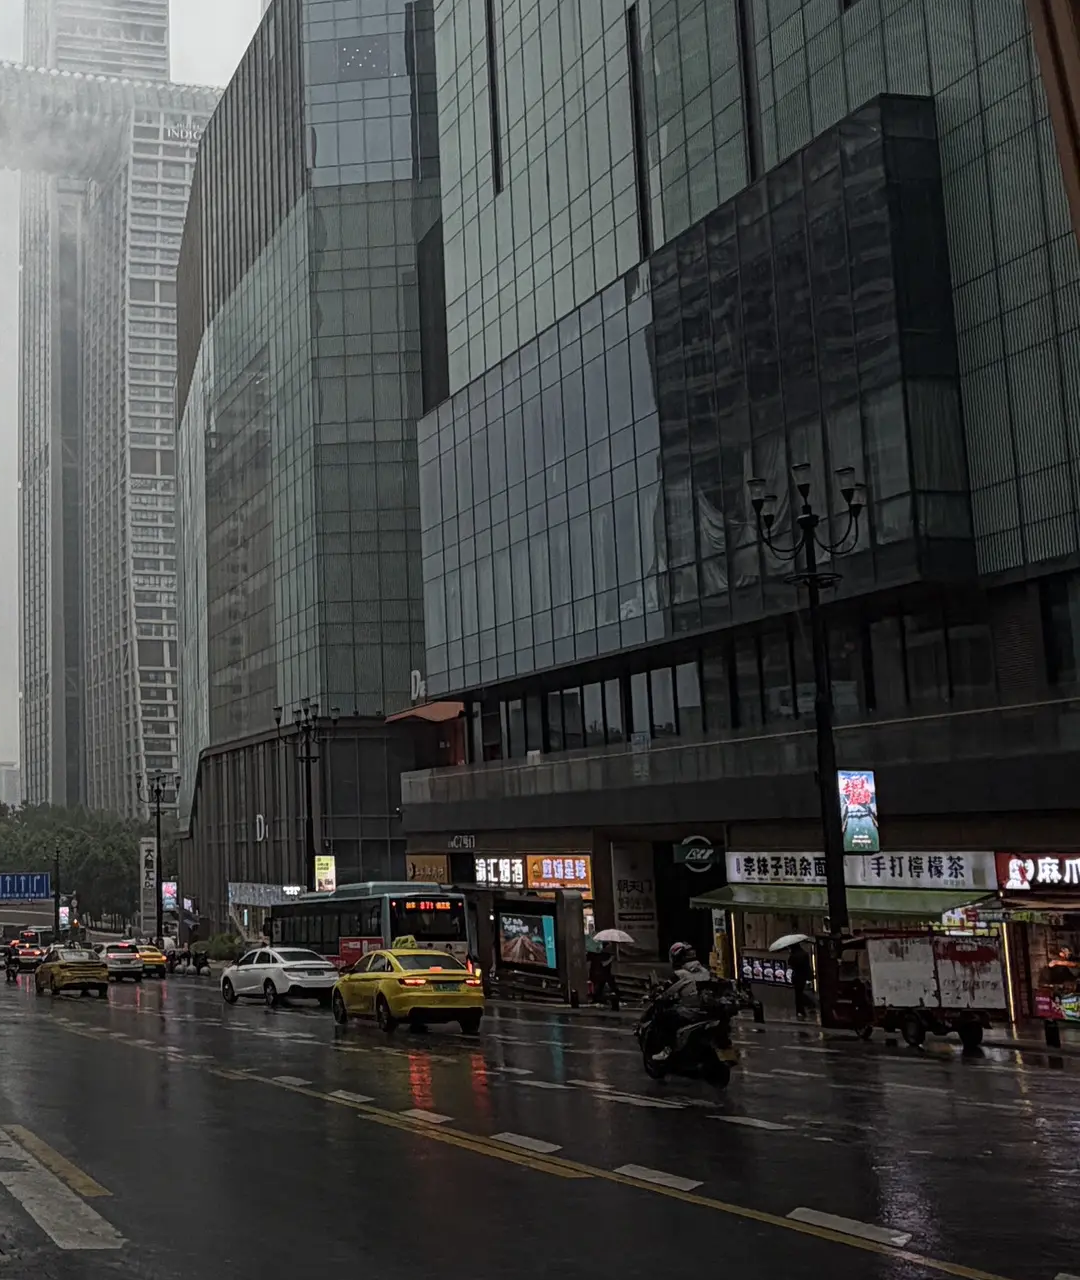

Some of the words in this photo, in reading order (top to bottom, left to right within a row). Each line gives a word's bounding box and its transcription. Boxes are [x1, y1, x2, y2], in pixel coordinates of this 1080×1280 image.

[871, 855, 966, 879] 手打檸檬茶
